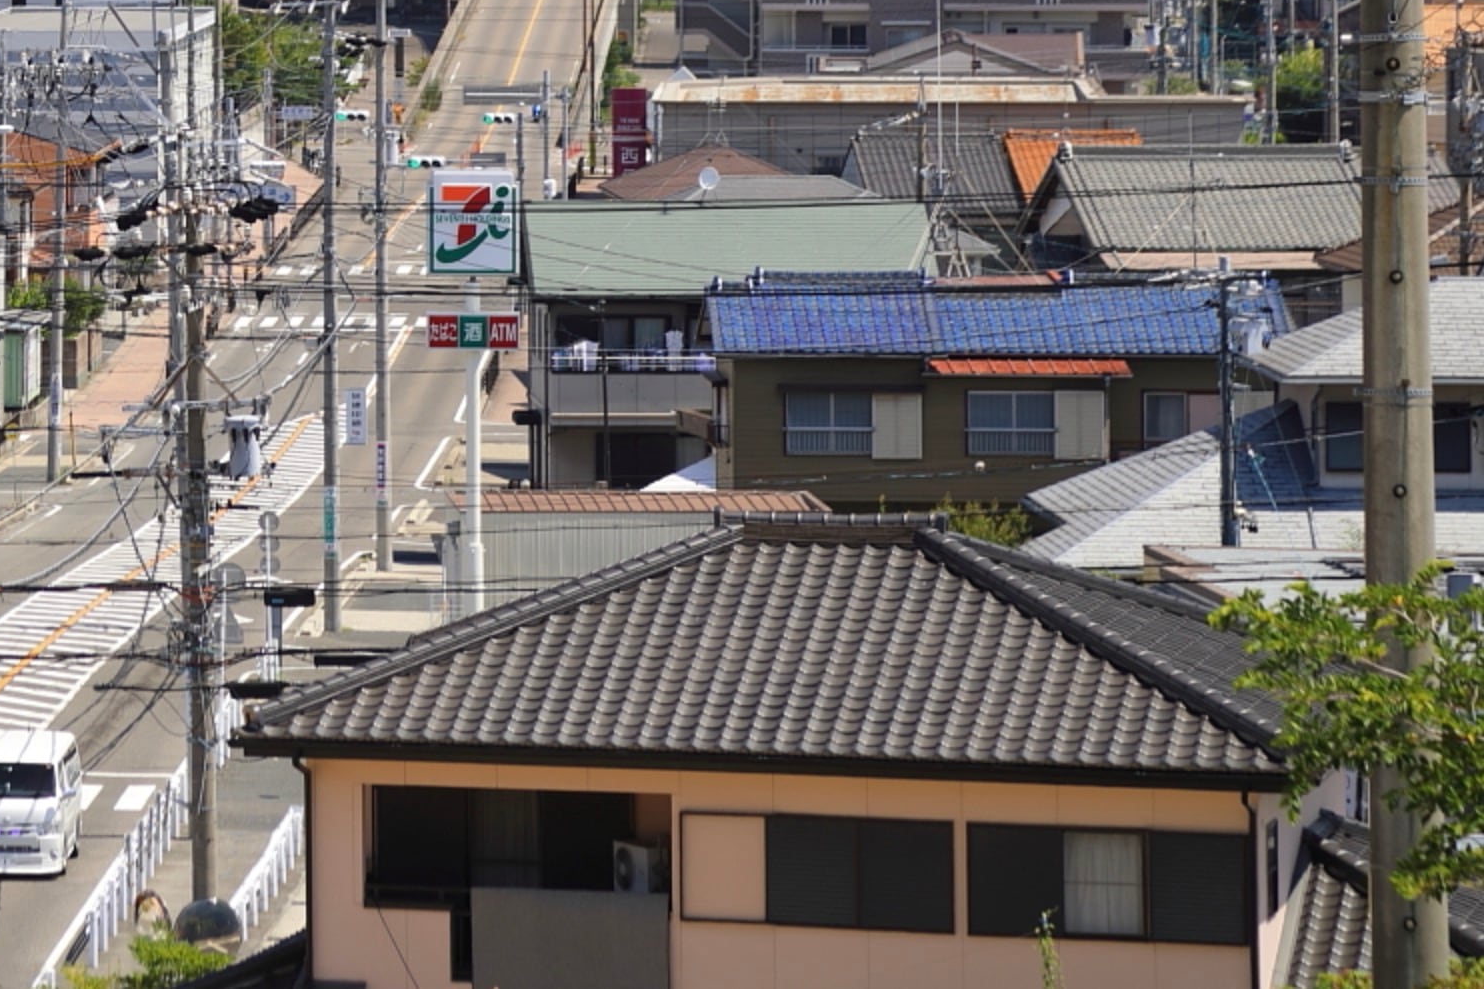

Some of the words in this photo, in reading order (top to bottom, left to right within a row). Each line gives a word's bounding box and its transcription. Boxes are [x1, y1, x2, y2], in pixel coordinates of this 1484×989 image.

[430, 322, 458, 342] たばこ
[464, 321, 483, 342] 酒
[490, 323, 517, 342] ATM
